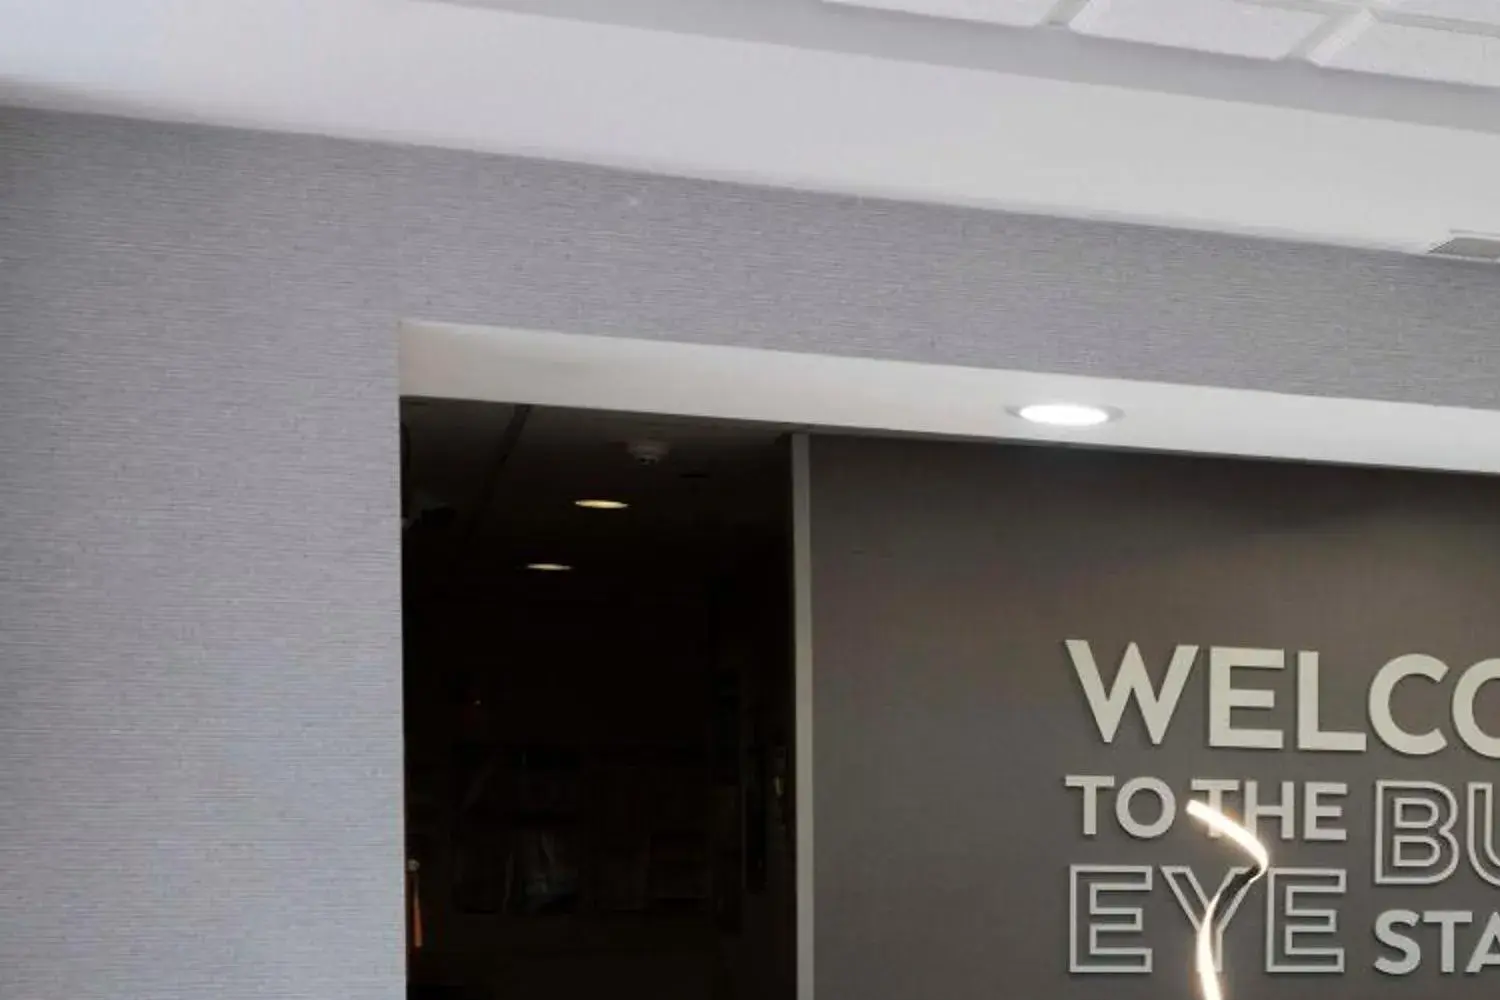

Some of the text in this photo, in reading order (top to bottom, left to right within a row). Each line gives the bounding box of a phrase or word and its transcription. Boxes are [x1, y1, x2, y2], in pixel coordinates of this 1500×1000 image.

[1065, 775, 1177, 839] TO
[1191, 779, 1347, 841] THE
[1069, 864, 1347, 975] EYE
